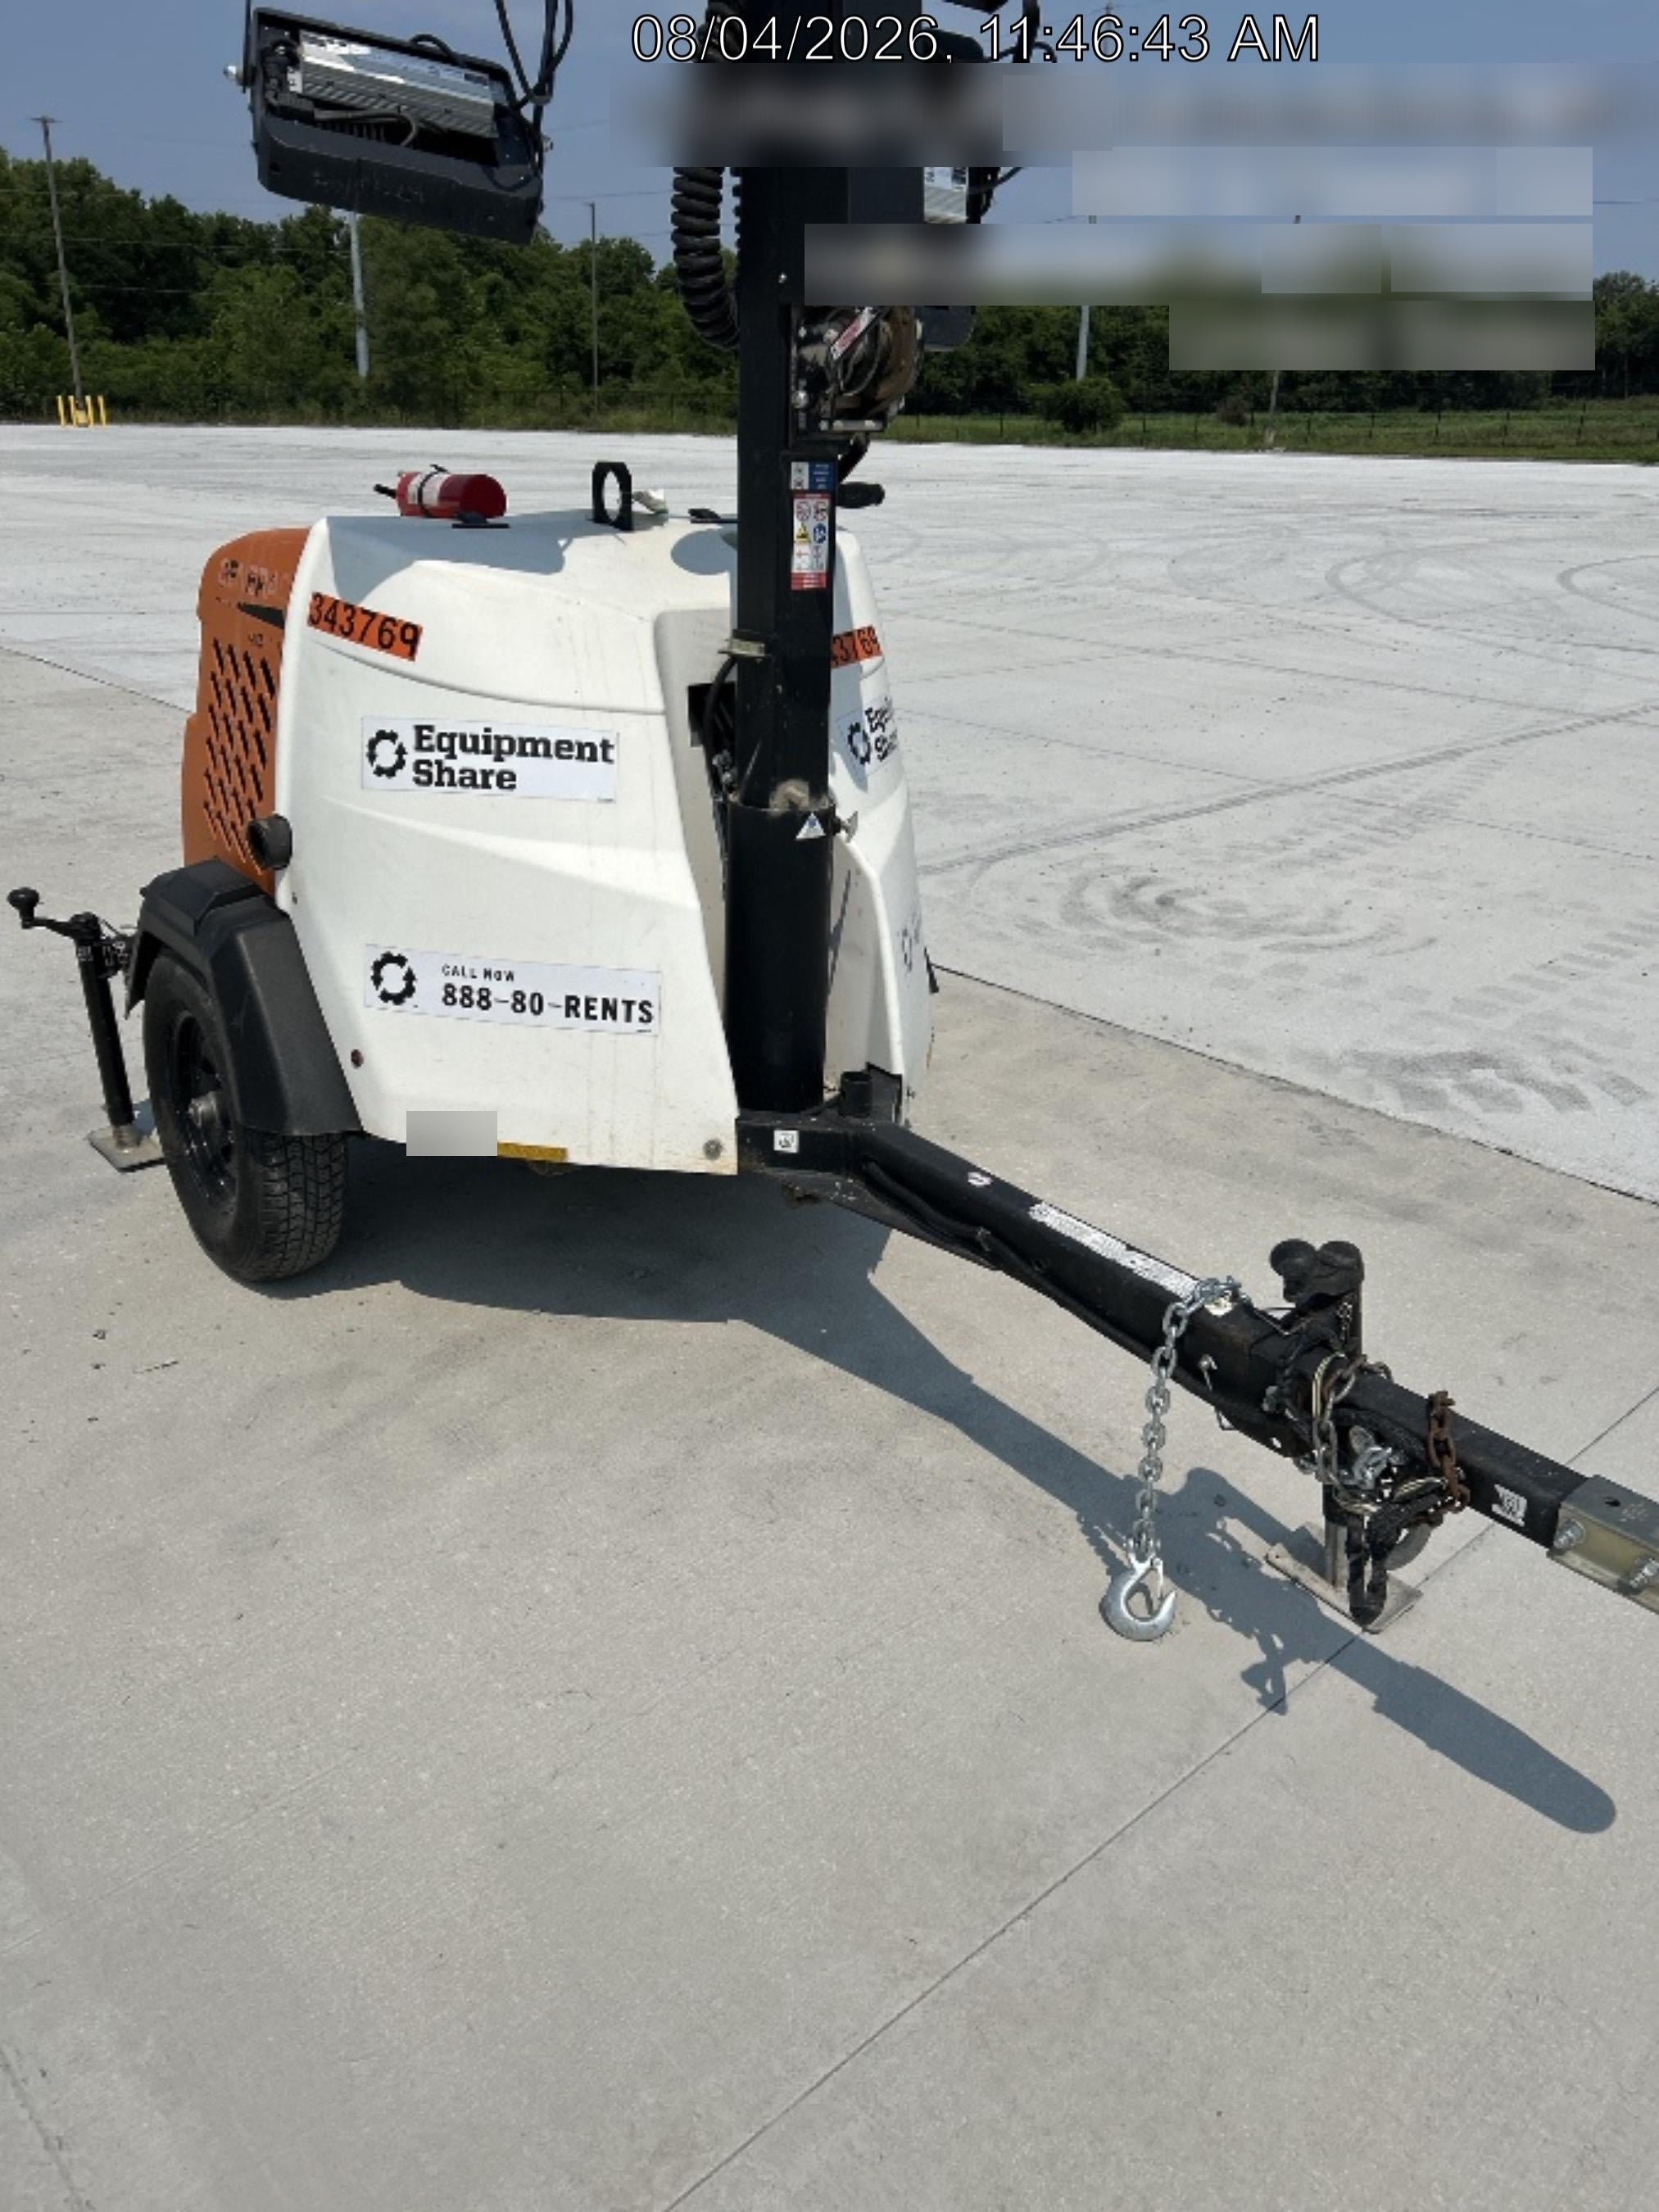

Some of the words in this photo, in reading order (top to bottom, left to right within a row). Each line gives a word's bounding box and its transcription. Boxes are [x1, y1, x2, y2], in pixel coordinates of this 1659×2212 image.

[309, 592, 421, 660] 343769
[413, 724, 615, 764] Equipment
[412, 759, 517, 790] Share
[442, 964, 478, 979] CALL
[441, 983, 654, 1024] 888-80-RENTS
